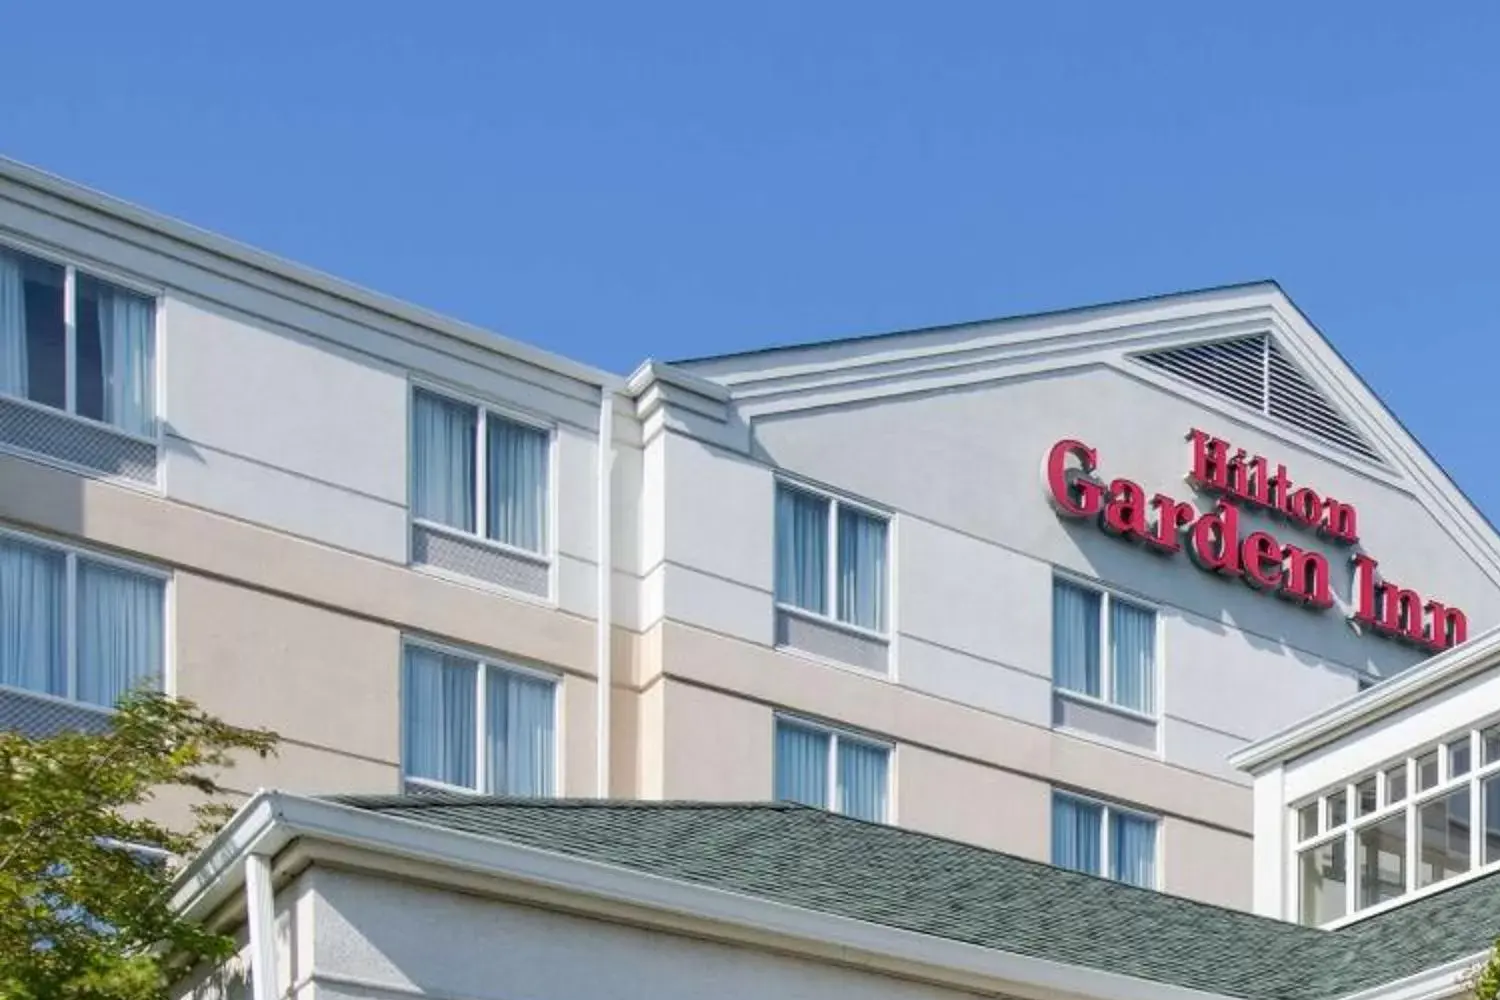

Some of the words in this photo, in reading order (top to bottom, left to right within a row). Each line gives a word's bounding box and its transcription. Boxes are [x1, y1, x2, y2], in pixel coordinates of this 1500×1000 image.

[1042, 439, 1334, 610] Garden
[1348, 553, 1468, 651] Inn
[1184, 428, 1360, 544] Hilton
